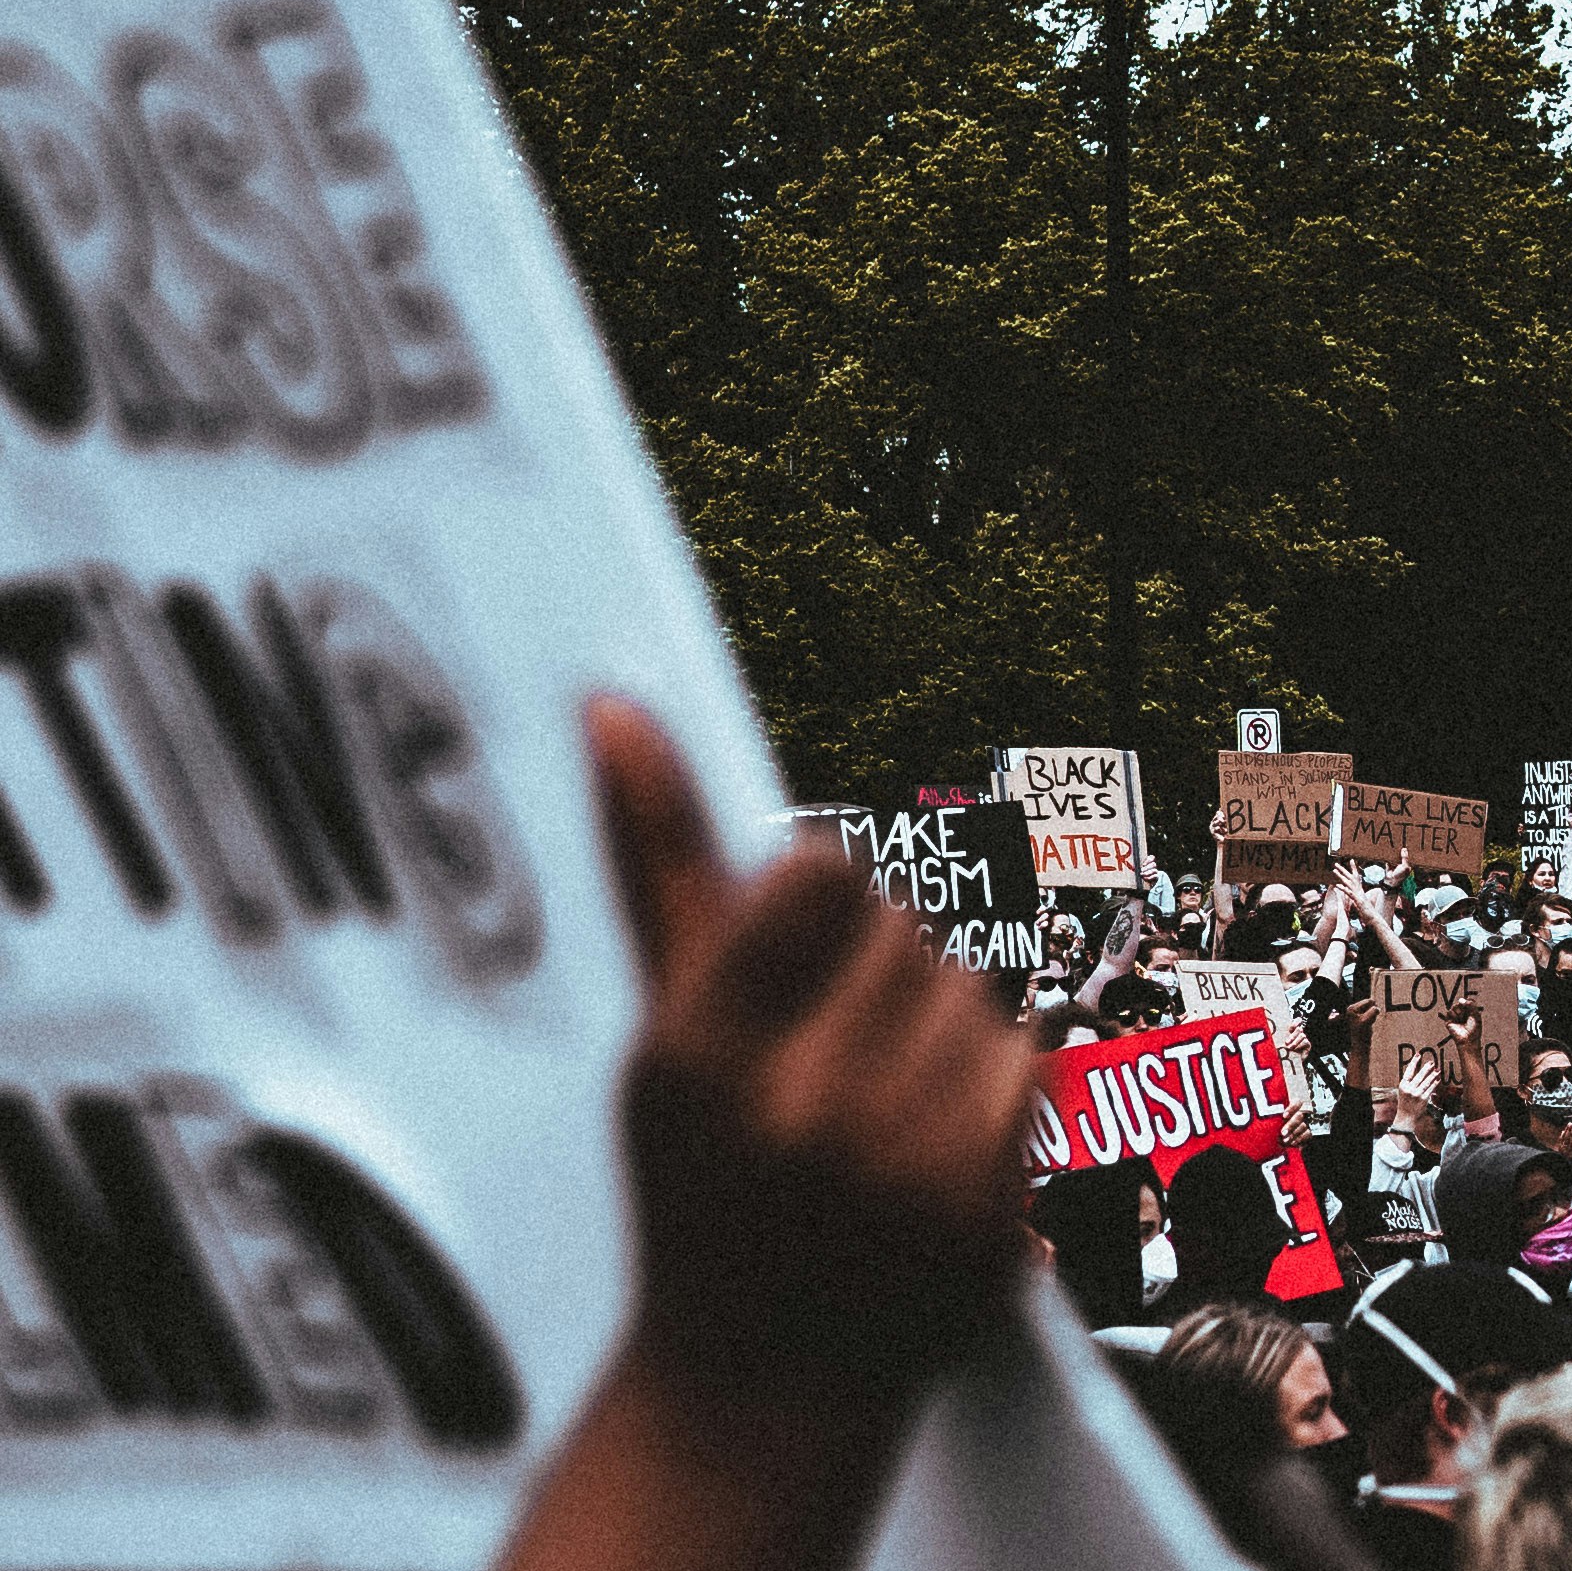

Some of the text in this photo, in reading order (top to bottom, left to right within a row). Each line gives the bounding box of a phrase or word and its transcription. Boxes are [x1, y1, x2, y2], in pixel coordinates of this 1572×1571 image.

[0, 560, 548, 998] TING
[1025, 755, 1121, 792] BLACK
[1223, 770, 1270, 786] STAND
[1021, 792, 1117, 820] IVES
[1347, 785, 1485, 828] BLACK LIVES
[1522, 784, 1571, 805] ANYWH
[840, 807, 967, 862] MAKE
[1226, 798, 1333, 836] BLACK
[1352, 817, 1460, 856] MATTER
[1524, 810, 1537, 824] IS
[1538, 810, 1549, 824] A
[1526, 829, 1545, 843] TO
[864, 856, 993, 913] ACISM
[938, 919, 1043, 972] AGAIN
[1194, 972, 1264, 1001] BLACK
[1384, 972, 1485, 1013] LOVE
[1397, 1042, 1504, 1086] POWR
[1077, 1030, 1285, 1165] JUSTICE
